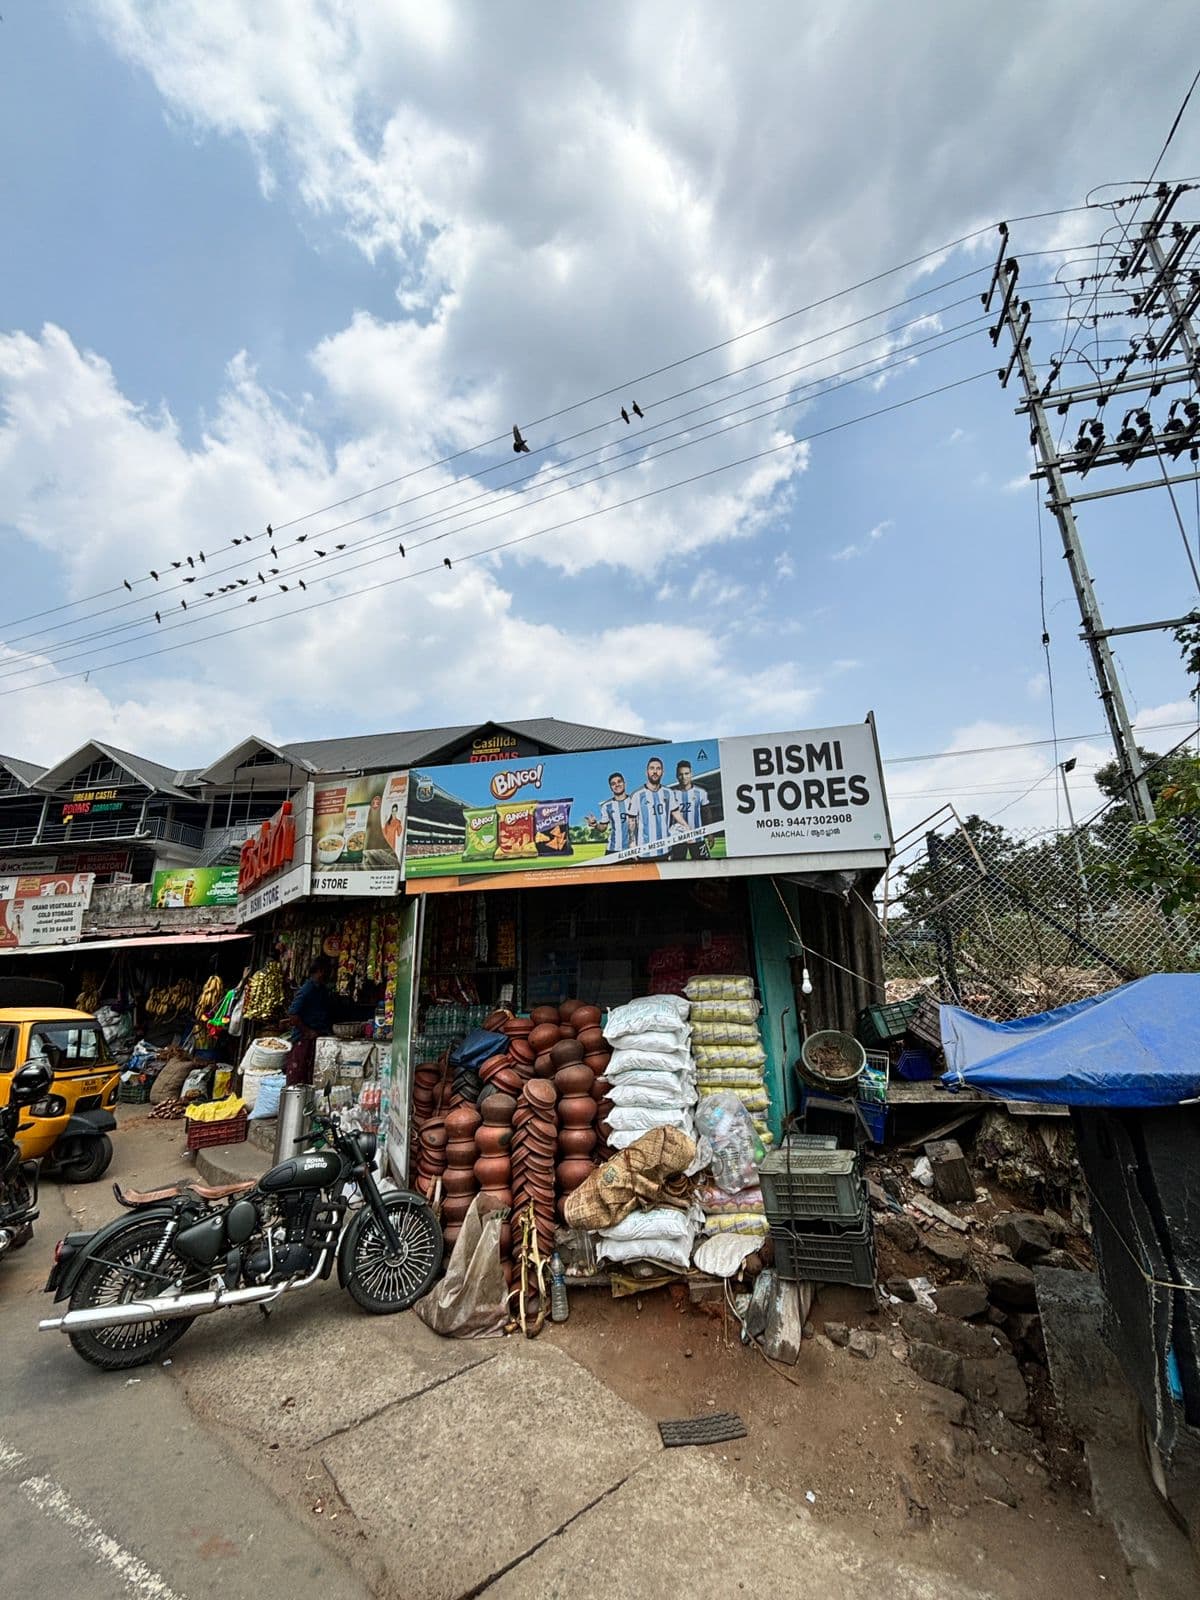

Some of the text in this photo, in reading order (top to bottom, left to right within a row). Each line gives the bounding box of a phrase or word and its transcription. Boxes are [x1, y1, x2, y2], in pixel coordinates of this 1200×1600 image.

[470, 752, 519, 763] ROOMS
[752, 740, 844, 777] BISMI
[493, 764, 543, 795] BINGO!
[72, 790, 118, 802] DREAM CASTLE
[736, 774, 870, 814] STORES
[62, 802, 91, 815] ROOMS
[653, 803, 664, 816] 10
[680, 802, 692, 813] 22
[536, 813, 565, 830] NACHOS
[620, 812, 627, 824] 9
[756, 813, 853, 829] MOB: 9447302908
[771, 830, 805, 839] ANACHAL
[648, 840, 665, 850] MESSI
[86, 853, 121, 861] MEDICAL
[77, 860, 124, 872] LABORATORY
[321, 878, 348, 889] STORE
[262, 885, 280, 908] STORE
[304, 1162, 328, 1170] ENFIELD
